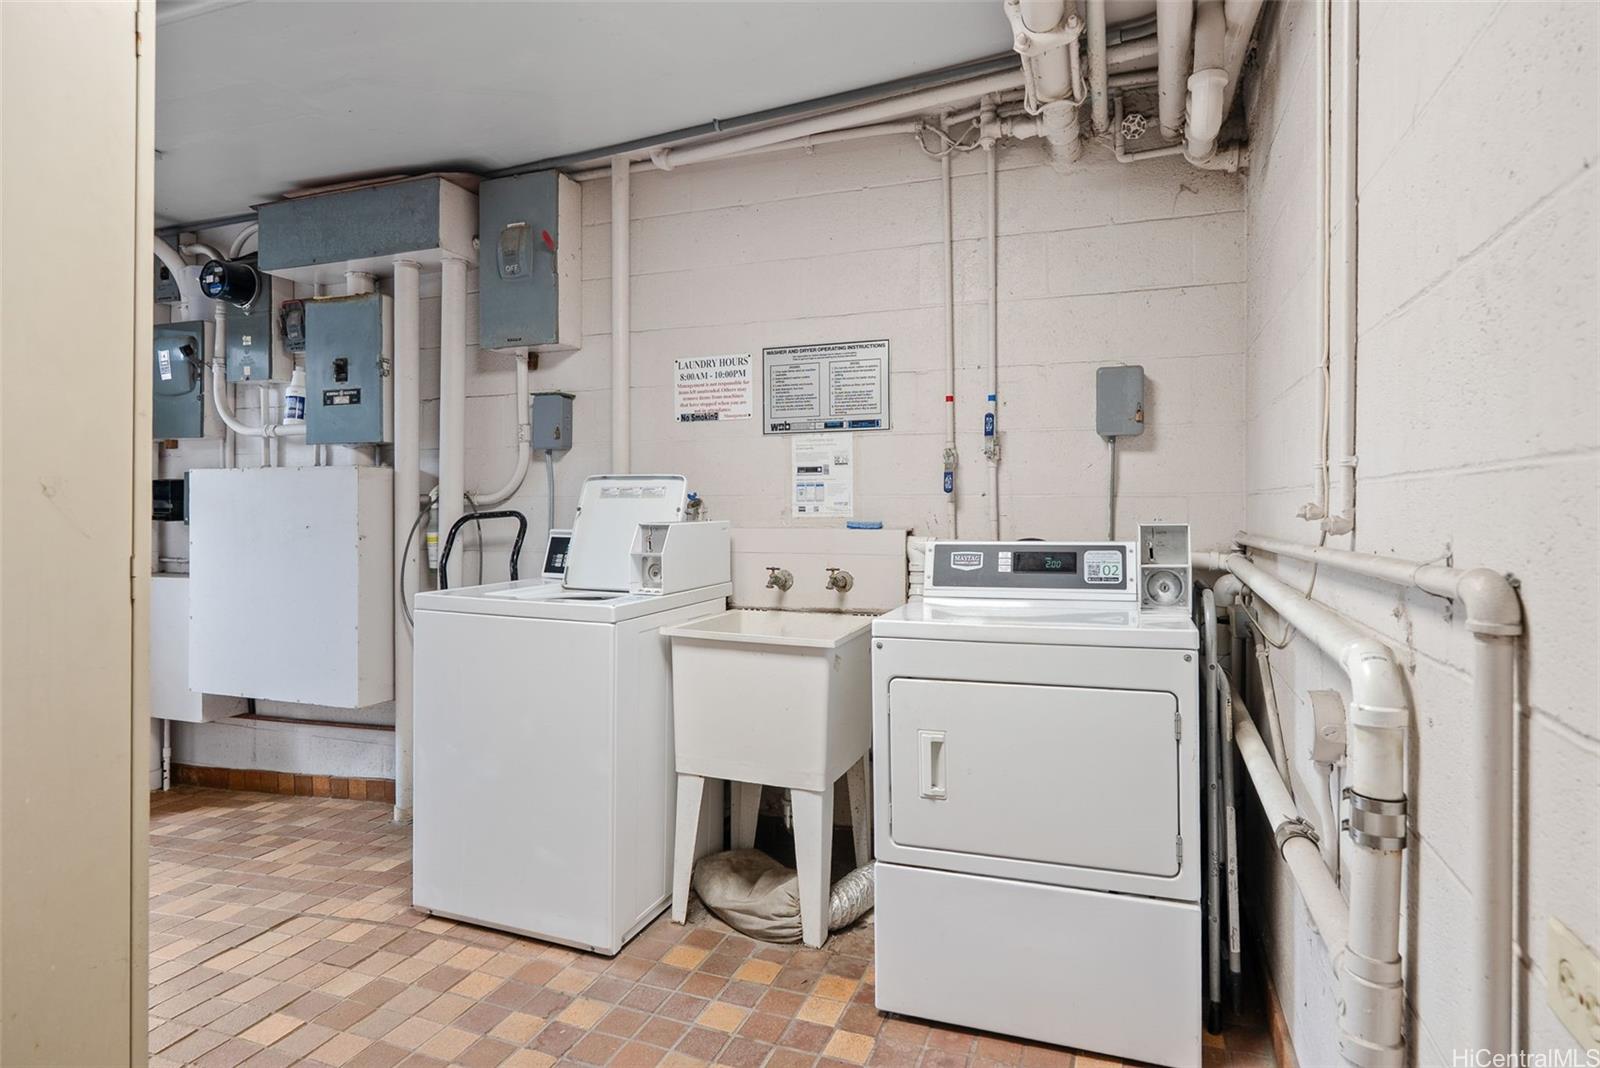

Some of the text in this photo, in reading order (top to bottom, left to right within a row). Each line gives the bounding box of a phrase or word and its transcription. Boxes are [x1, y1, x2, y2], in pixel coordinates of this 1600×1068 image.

[505, 264, 518, 273] OFF
[817, 345, 847, 353] OPERATING
[678, 357, 749, 370] LAUNDRY HOURS
[680, 371, 708, 381] 8:00AM
[715, 369, 746, 379] 10:00PM
[681, 412, 719, 422] No Smoking
[954, 554, 980, 562] MAYTAG
[1102, 564, 1120, 576] 02
